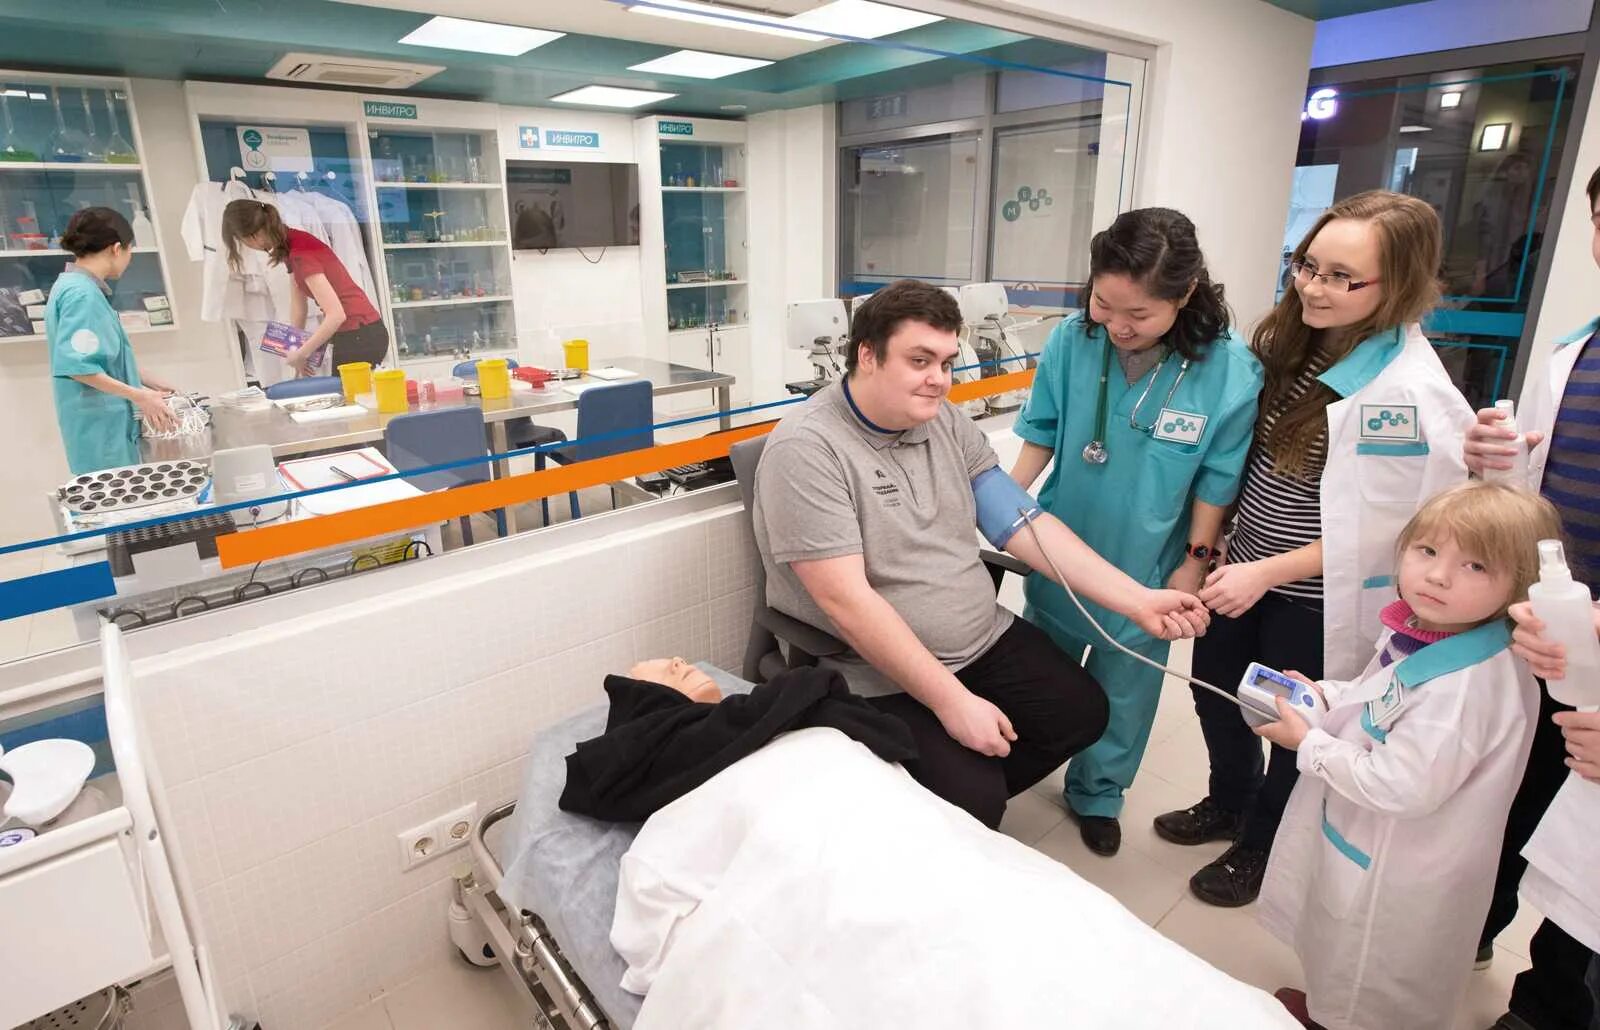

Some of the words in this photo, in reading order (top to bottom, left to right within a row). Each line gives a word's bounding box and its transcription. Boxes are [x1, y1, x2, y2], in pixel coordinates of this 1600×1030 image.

[367, 103, 416, 117] ИНВИТРО
[1301, 88, 1338, 121] G
[551, 132, 593, 145] ИНВИТРО
